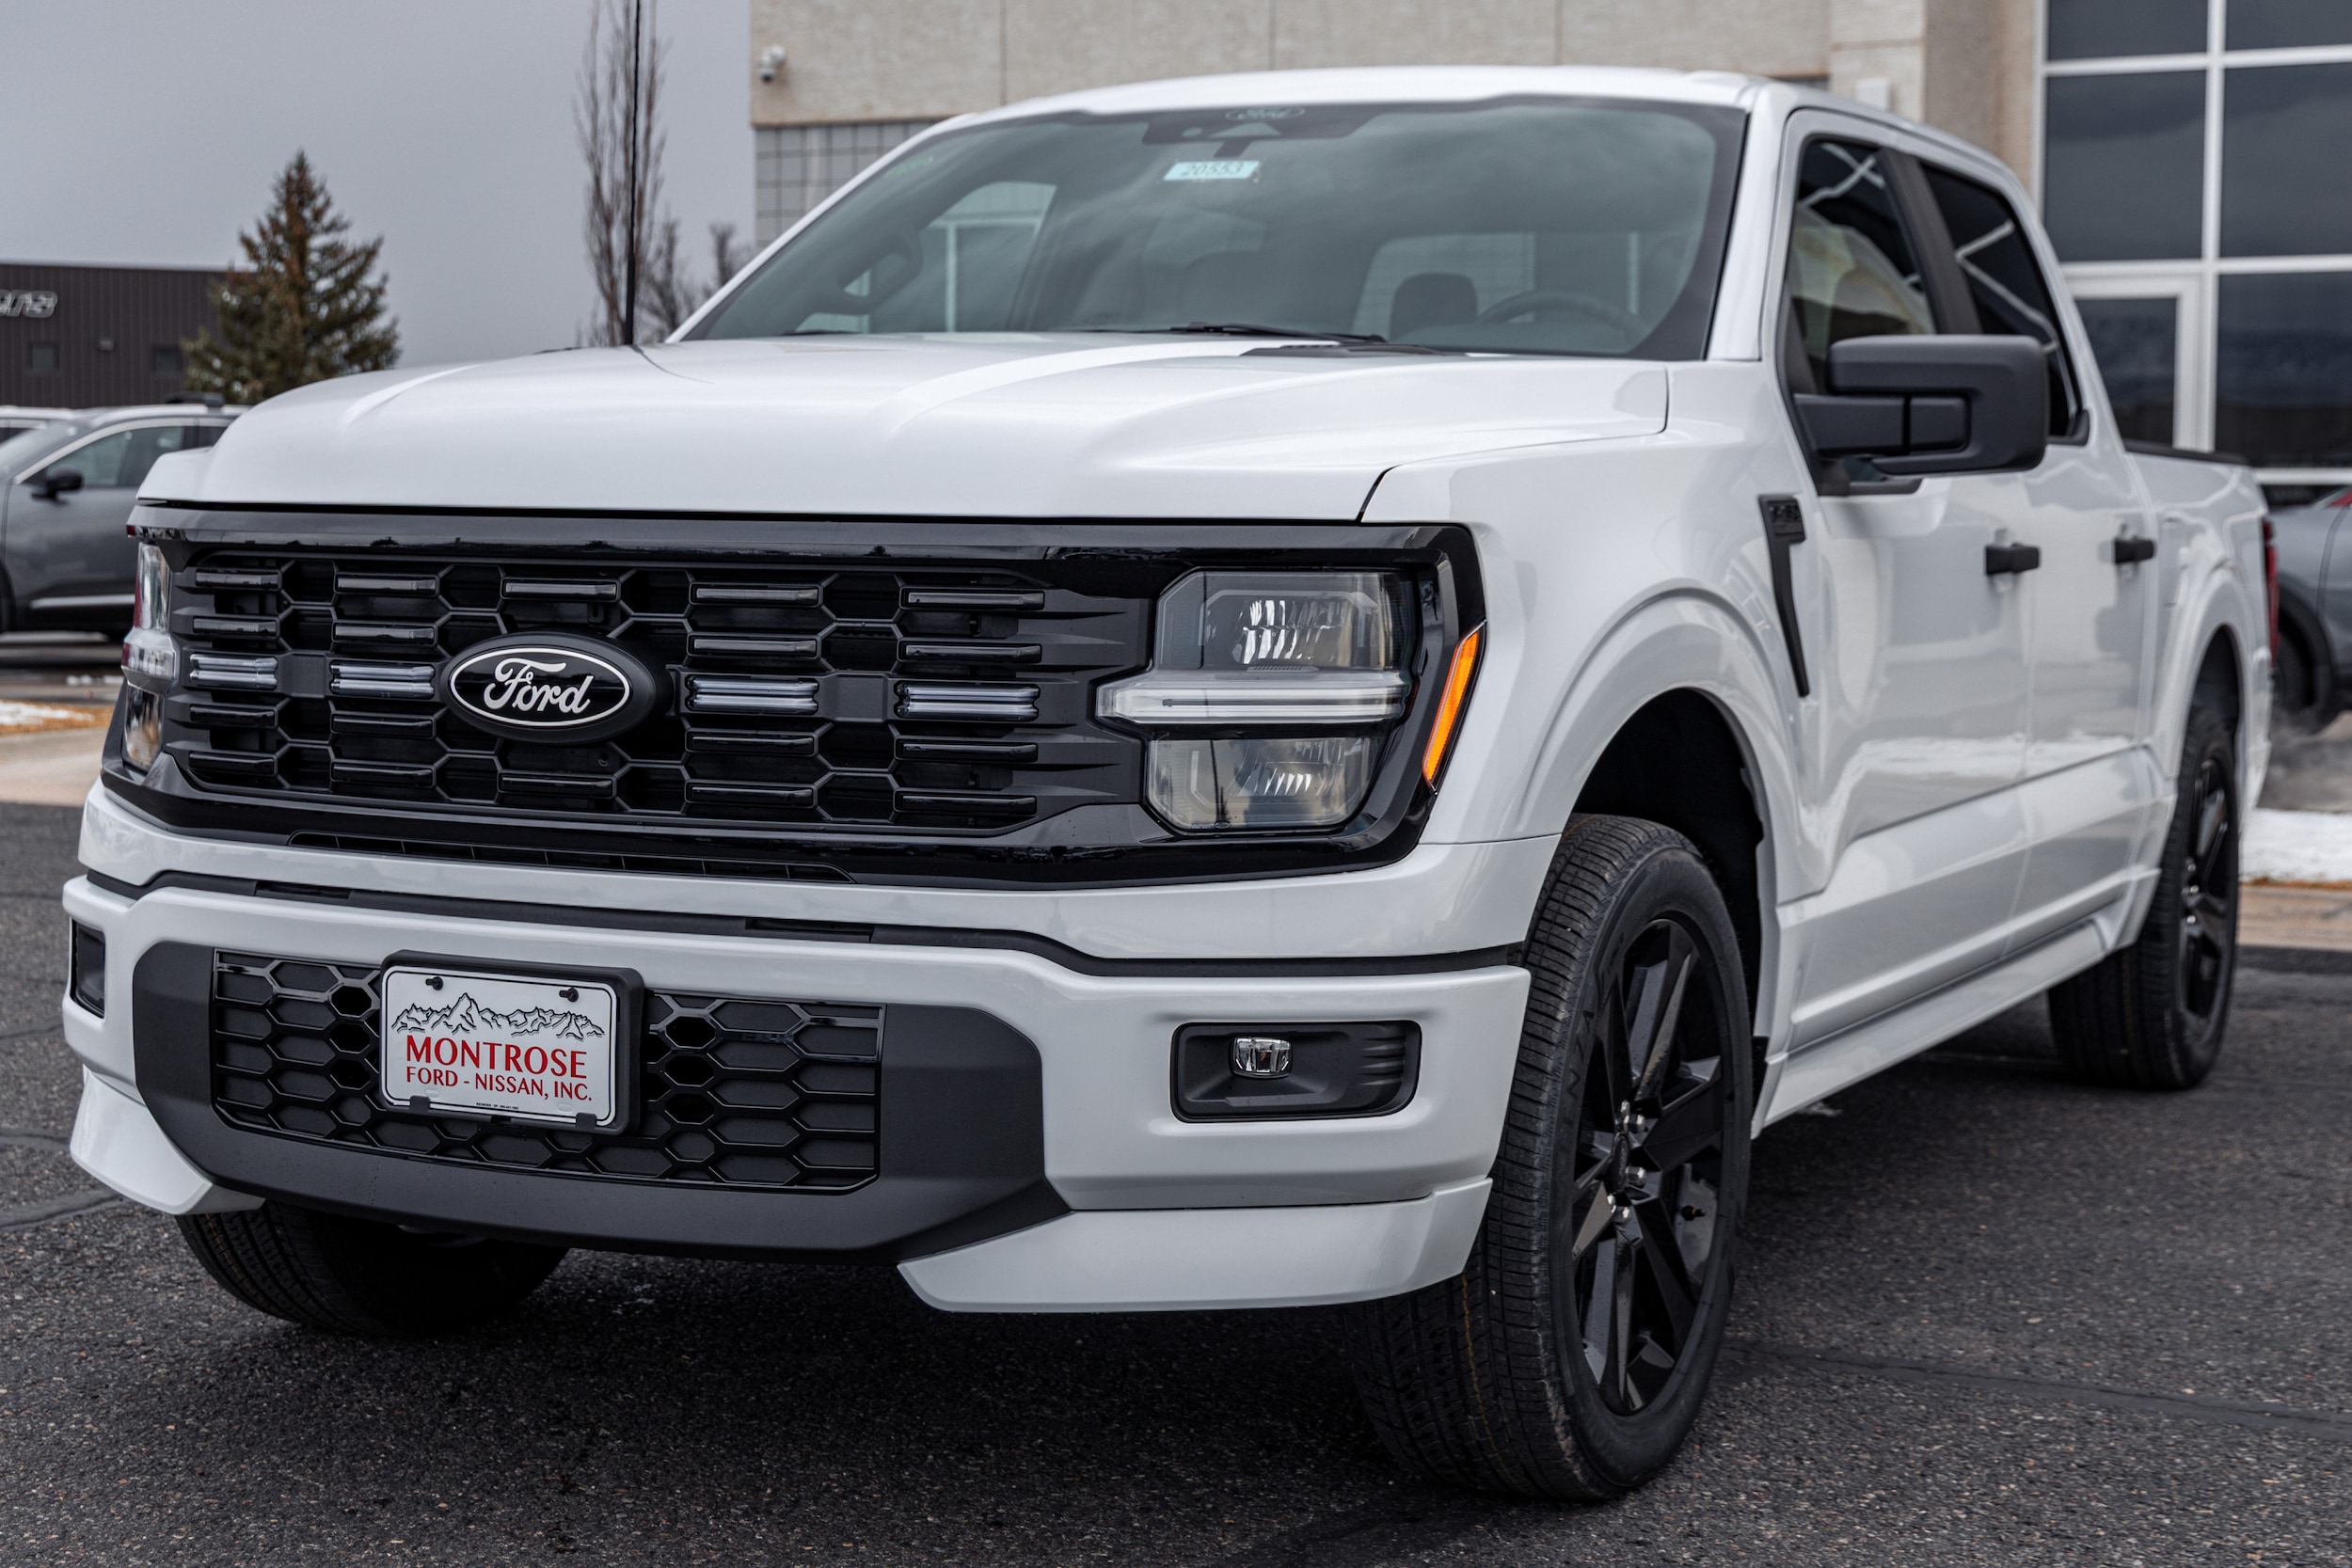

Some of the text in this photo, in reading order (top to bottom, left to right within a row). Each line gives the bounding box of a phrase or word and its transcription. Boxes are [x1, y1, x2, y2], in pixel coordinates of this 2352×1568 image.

[1181, 162, 1244, 176] 20553
[484, 657, 595, 714] Ford
[406, 1035, 588, 1080] MONTROSE
[406, 1066, 459, 1087] FORD
[475, 1072, 549, 1101] NISSAN,
[553, 1080, 593, 1102] INC.
